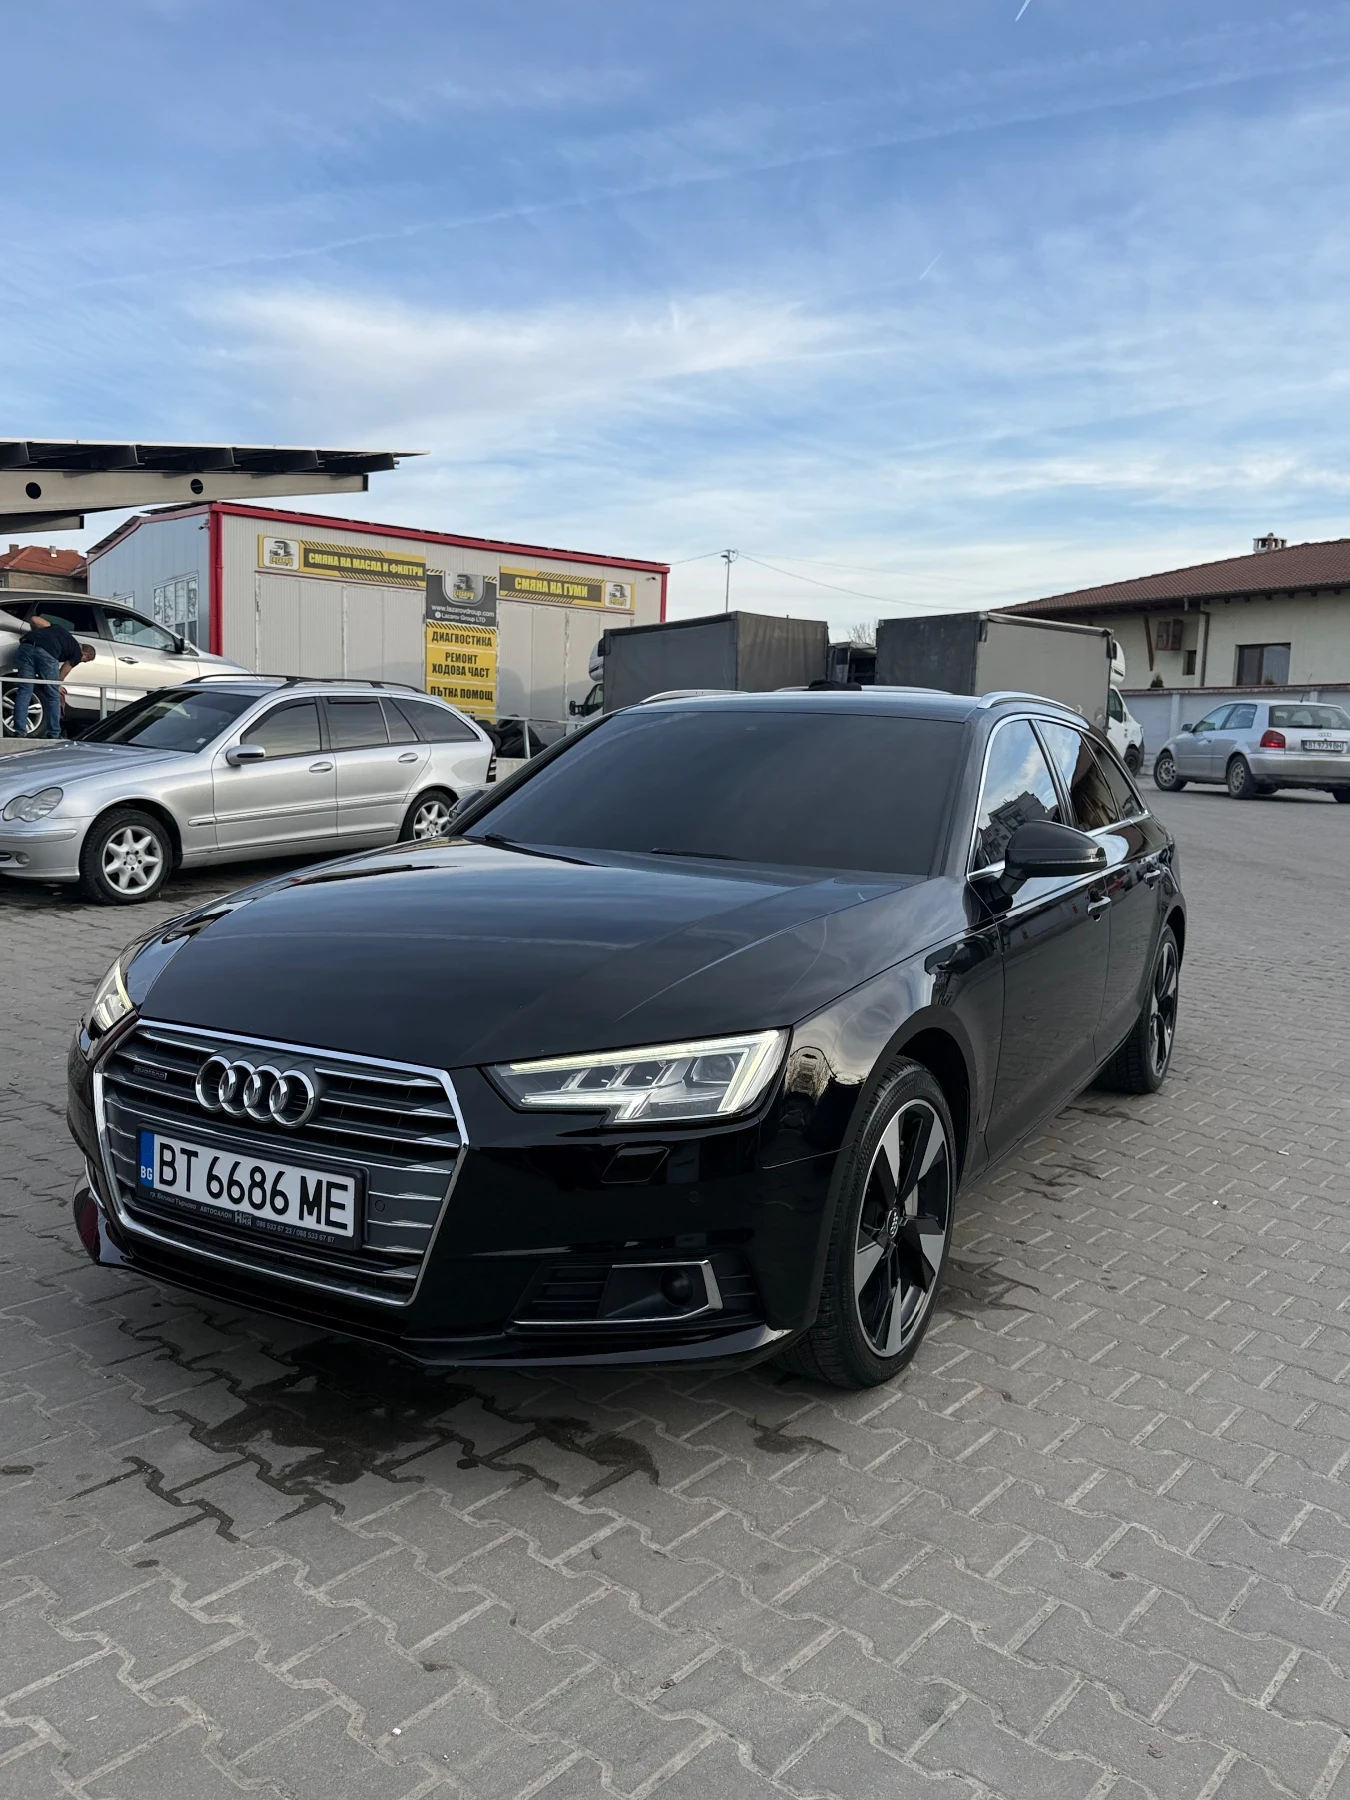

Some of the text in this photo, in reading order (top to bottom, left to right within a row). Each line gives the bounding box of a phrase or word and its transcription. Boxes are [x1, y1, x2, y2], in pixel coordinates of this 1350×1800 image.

[308, 552, 424, 577] СМЯНА НА МАСЛА И ФИЛТРИ
[514, 577, 588, 598] СМЯНА НА ГУМИ
[460, 614, 476, 622] Group
[431, 631, 493, 647] ДИАГНОСТИКА
[445, 651, 478, 665] РЕМОНТ
[431, 663, 491, 679] ХОДОВА ЧАСТ
[430, 686, 494, 702] ПЪТНА ПОМОЩ
[140, 1165, 153, 1181] BG
[206, 1156, 290, 1217] 6686
[200, 1206, 233, 1219] АВТОСАЛОН
